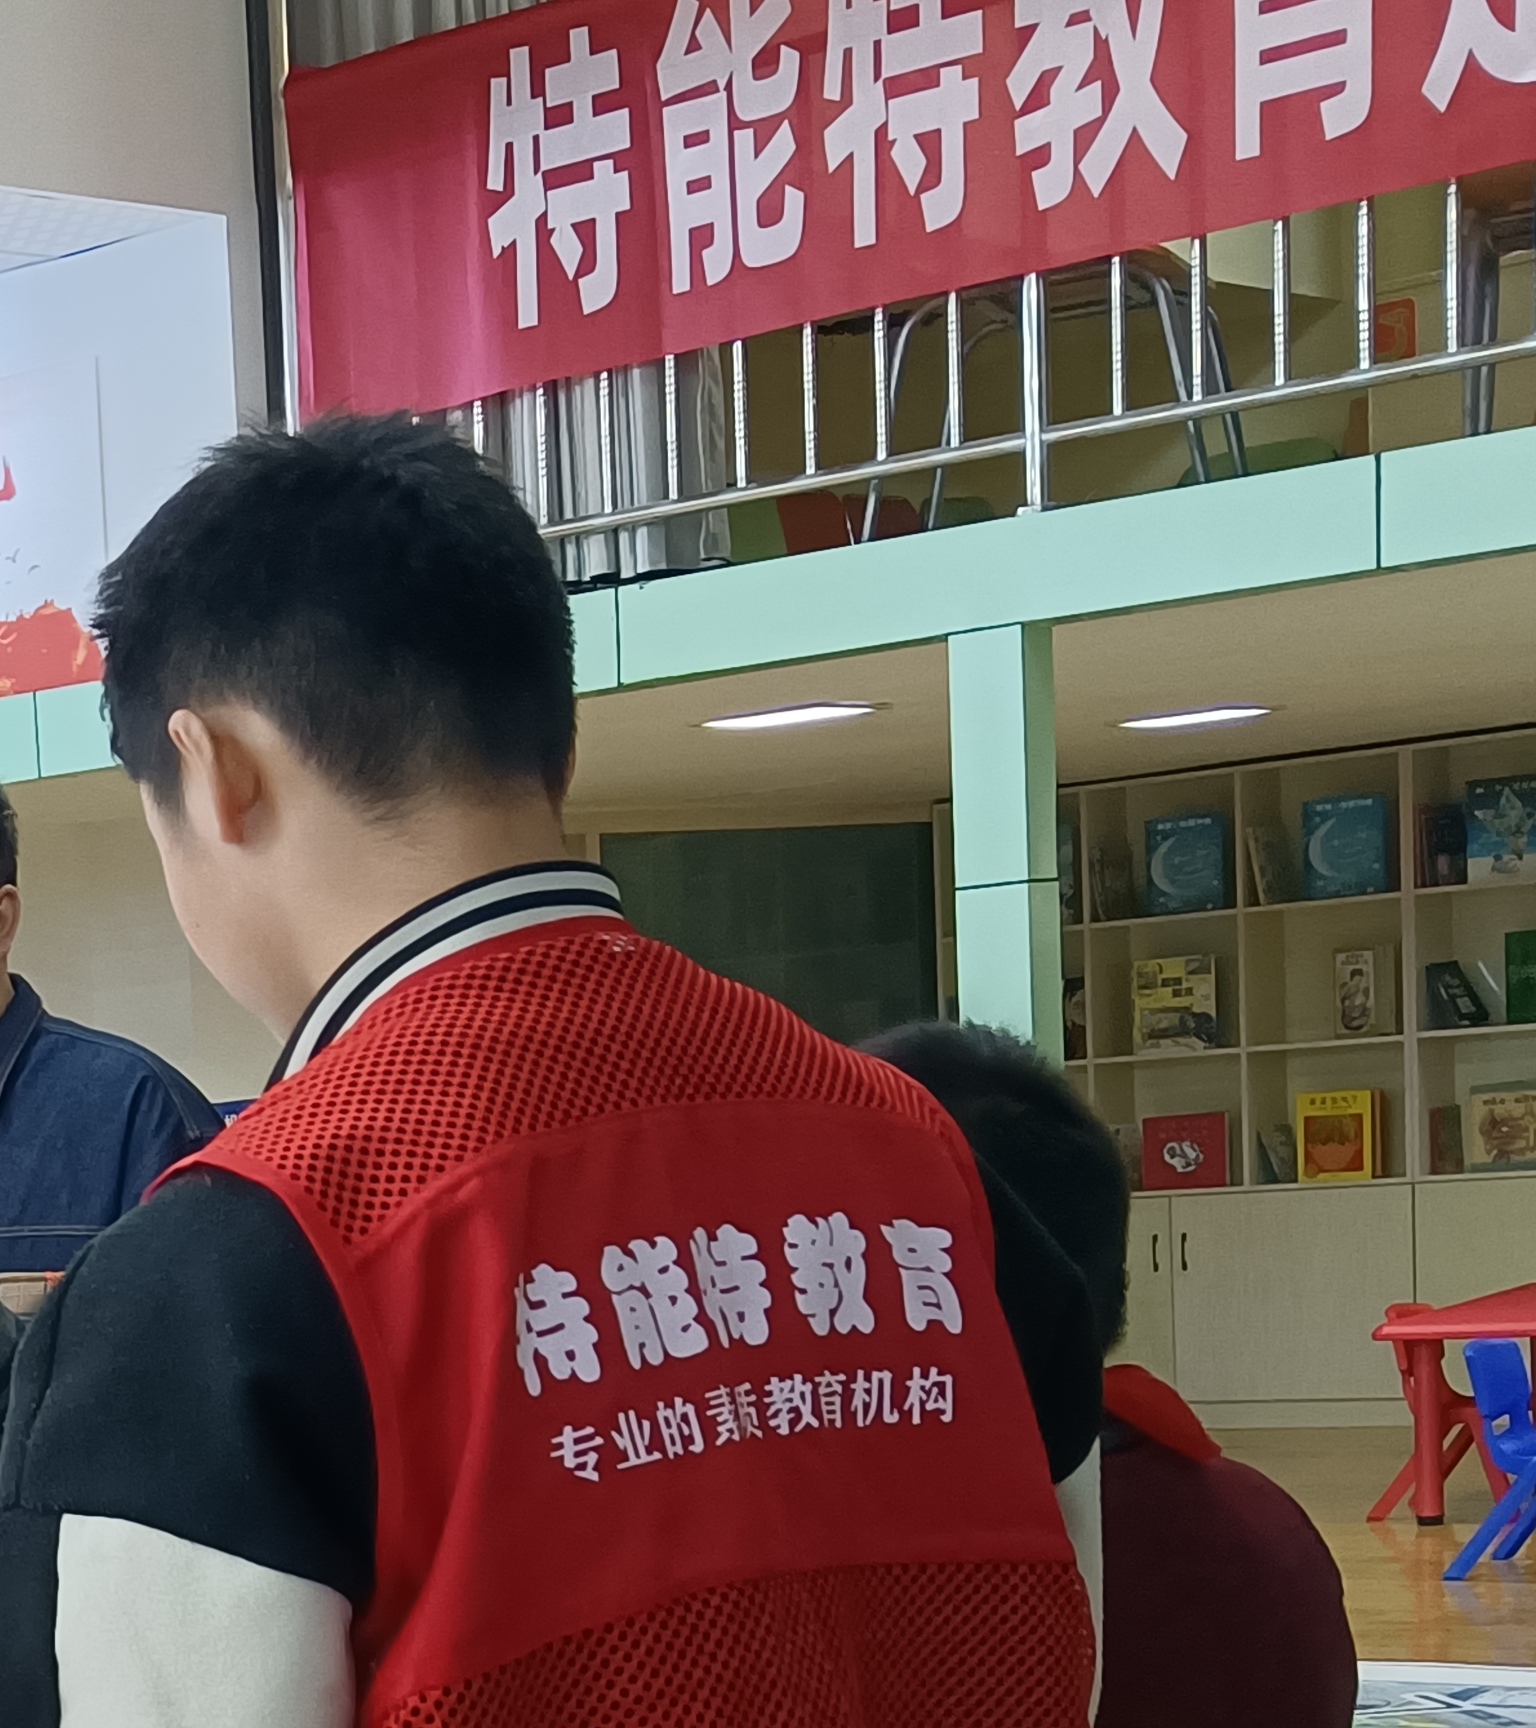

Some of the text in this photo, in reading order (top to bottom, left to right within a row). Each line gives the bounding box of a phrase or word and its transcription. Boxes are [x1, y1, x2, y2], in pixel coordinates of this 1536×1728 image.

[486, 0, 1536, 329] 特能特教育
[514, 1211, 963, 1397] 特能特教育
